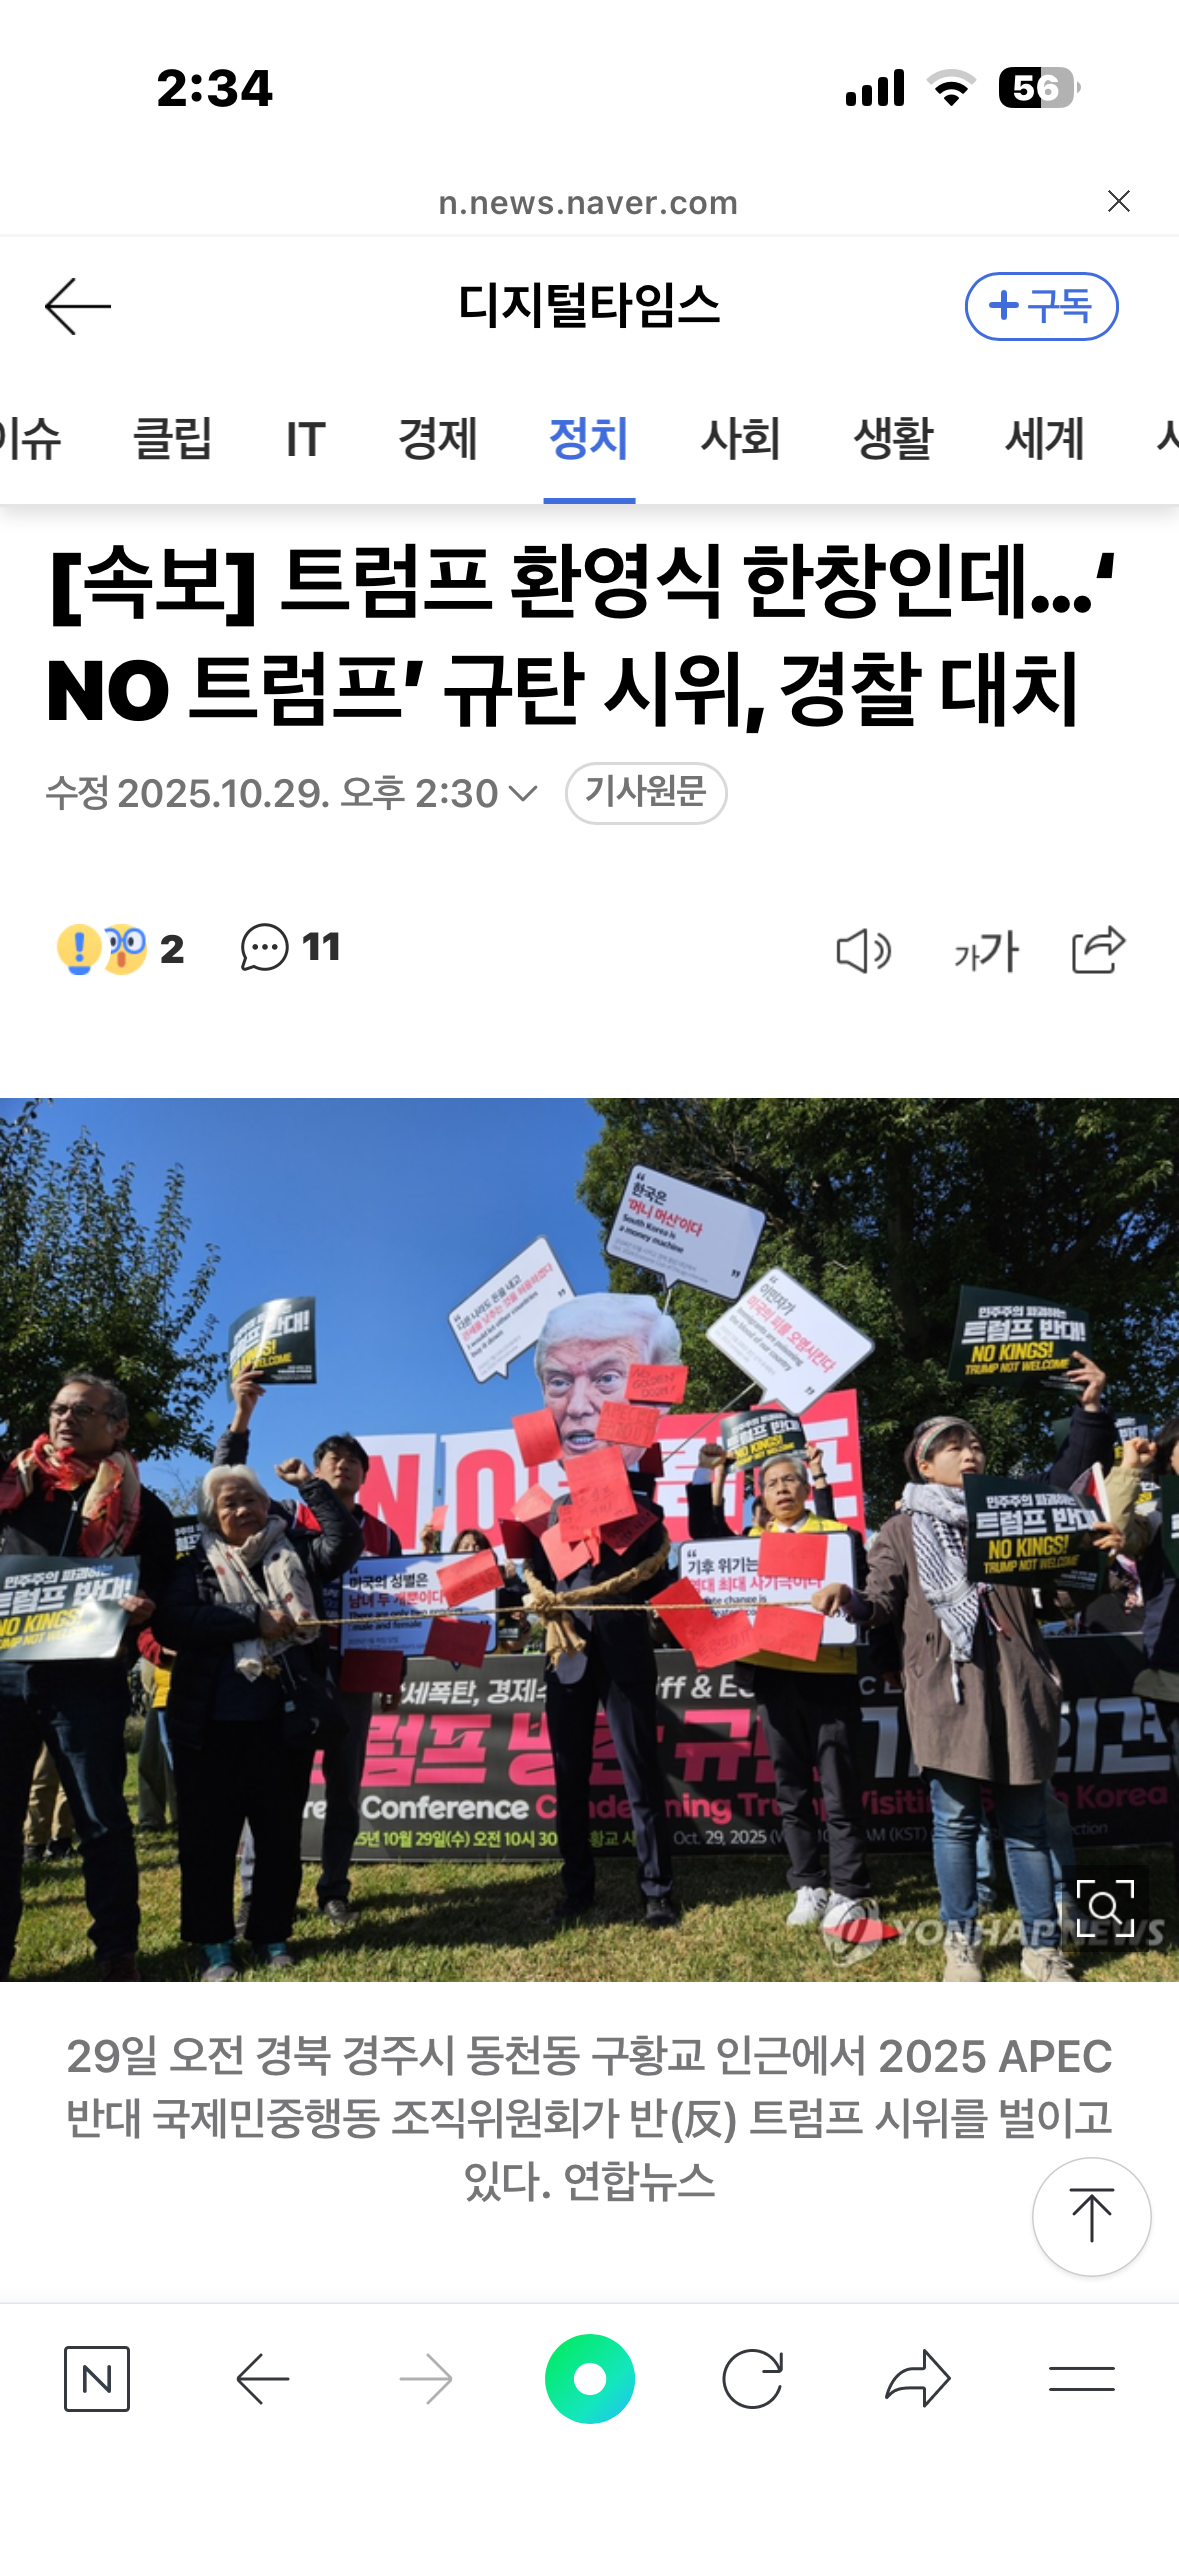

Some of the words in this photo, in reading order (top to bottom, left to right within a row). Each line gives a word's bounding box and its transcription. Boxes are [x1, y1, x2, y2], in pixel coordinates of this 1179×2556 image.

[158, 69, 273, 107] 2:34
[1011, 73, 1060, 103] 56
[439, 189, 737, 216] n.news.naver.com
[461, 282, 720, 328] 디지털타임스
[1028, 289, 1092, 327] 구독
[134, 417, 210, 459] 클립
[288, 422, 326, 456] IT
[399, 417, 476, 460] 경제
[550, 417, 626, 460] 정치
[701, 417, 778, 460] 사회
[854, 417, 934, 460] 생활
[1005, 417, 1083, 460] 세계
[53, 545, 254, 627] [속보]
[281, 544, 492, 618] 트럼프
[511, 544, 719, 619] 환영식
[49, 659, 169, 721] NO
[444, 652, 585, 727] 규탄
[604, 652, 764, 733] 시위,
[781, 652, 922, 727] 경찰
[942, 652, 1075, 727] 대치
[46, 775, 107, 810] 수정
[119, 779, 329, 808] 2025.10.29.
[341, 775, 405, 810] 오후
[417, 779, 498, 808] 2:30
[586, 775, 706, 808] 기사원문
[161, 935, 184, 963] 2
[303, 932, 339, 960] 11
[632, 1182, 667, 1206] 한국은
[623, 1214, 646, 1229] South
[646, 1222, 669, 1238] Korea
[624, 1227, 651, 1242] money
[652, 1236, 684, 1253] machine
[978, 1305, 1023, 1319] 민주주의
[1026, 1306, 1067, 1319] 파괴하는
[961, 1319, 1034, 1345] 트럼프
[1039, 1319, 1086, 1342] 반대!
[965, 1363, 999, 1375] TRUMP
[1000, 1361, 1020, 1374] NOT
[1022, 1358, 1070, 1372] WELCOME
[971, 1343, 996, 1363] NO
[999, 1341, 1054, 1361] KINGS!
[358, 1449, 515, 1557] NO
[986, 1494, 1033, 1509] 민주주의
[975, 1509, 1047, 1538] 트럼프
[988, 1539, 1012, 1559] NO
[1016, 1534, 1069, 1557] KINGS!
[688, 1558, 715, 1575] 기후
[718, 1557, 758, 1574] 위기는
[984, 1560, 1017, 1574] TRUMP
[1019, 1558, 1037, 1572] NOT
[1039, 1554, 1080, 1569] WELCOME
[4, 1571, 59, 1590] 민주주의
[72, 1573, 133, 1607] 반대!
[350, 1574, 387, 1590] 미국의
[390, 1573, 428, 1588] 성별은
[718, 1576, 747, 1592] 최대
[348, 1610, 375, 1620] There
[349, 1593, 374, 1608] 남녀
[377, 1593, 390, 1607] 두
[352, 1622, 376, 1632] male
[377, 1620, 391, 1631] and
[392, 1619, 422, 1631] female
[309, 1713, 492, 1787] 럼프
[361, 1795, 530, 1820] Conference
[1076, 1783, 1168, 1809] Korea
[383, 1831, 413, 1847] 10월
[416, 1831, 471, 1848] 29일(수)
[473, 1831, 501, 1847] 오전
[504, 1831, 535, 1847] 10시
[538, 1831, 559, 1847] 30
[589, 1830, 619, 1848] 황교
[674, 1832, 700, 1846] Oct.
[705, 1831, 727, 1847] 29,
[730, 1830, 767, 1845] 2025
[888, 1825, 927, 1843] (KST)
[68, 2035, 156, 2075] 29일
[170, 2035, 242, 2074] 오전
[257, 2035, 331, 2076] 경북
[344, 2035, 452, 2076] 경주시
[467, 2035, 580, 2076] 동천동
[592, 2035, 705, 2076] 구황교
[717, 2035, 863, 2076] 인근에서
[880, 2039, 985, 2073] 2025
[999, 2039, 1112, 2073] APEC
[68, 2098, 139, 2139] 반대
[153, 2098, 380, 2139] 국제민중행동
[392, 2098, 620, 2139] 조직위원회가
[631, 2098, 736, 2143] 반(反)
[750, 2098, 863, 2138] 트럼프
[876, 2098, 988, 2139] 시위를
[1001, 2098, 1112, 2139] 벌이고
[465, 2161, 550, 2202] 있다.
[565, 2161, 715, 2202] 연합뉴스
